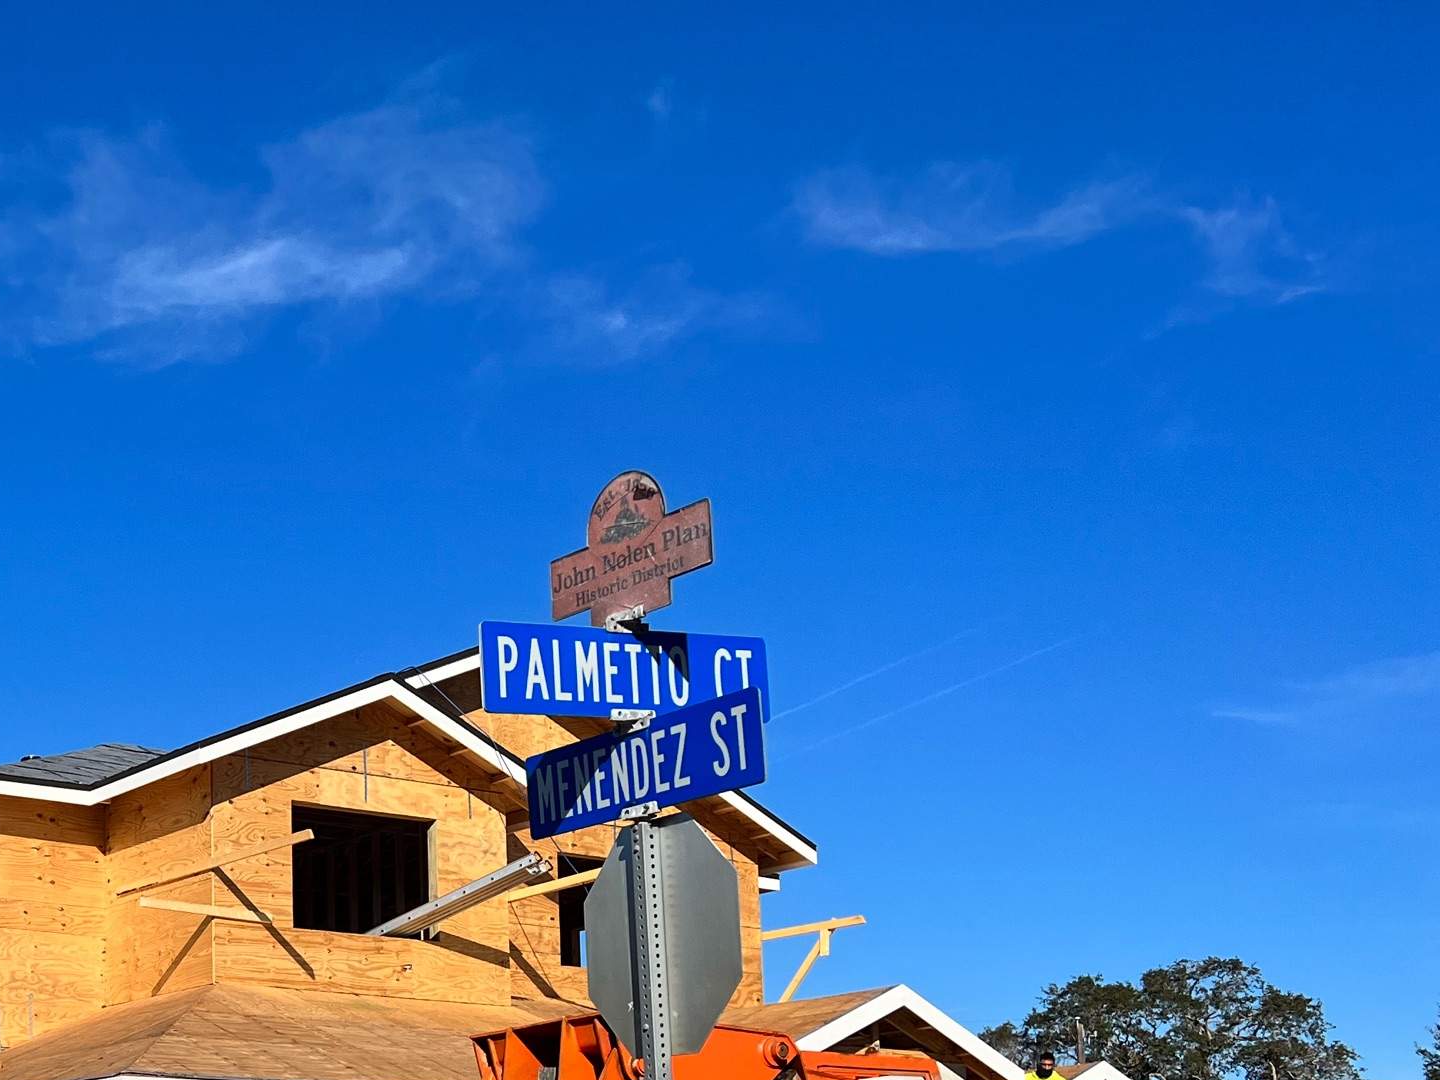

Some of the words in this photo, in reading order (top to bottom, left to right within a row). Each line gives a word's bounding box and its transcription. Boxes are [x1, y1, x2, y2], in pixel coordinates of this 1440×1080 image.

[554, 564, 596, 594] John
[602, 542, 656, 575] Nolen
[662, 521, 709, 551] Plan
[576, 577, 629, 607] Historic
[632, 555, 684, 587] District
[497, 635, 690, 706] PALMETTO
[713, 647, 752, 698] CT
[536, 722, 691, 825] MENENDEZ
[710, 704, 747, 776] ST
